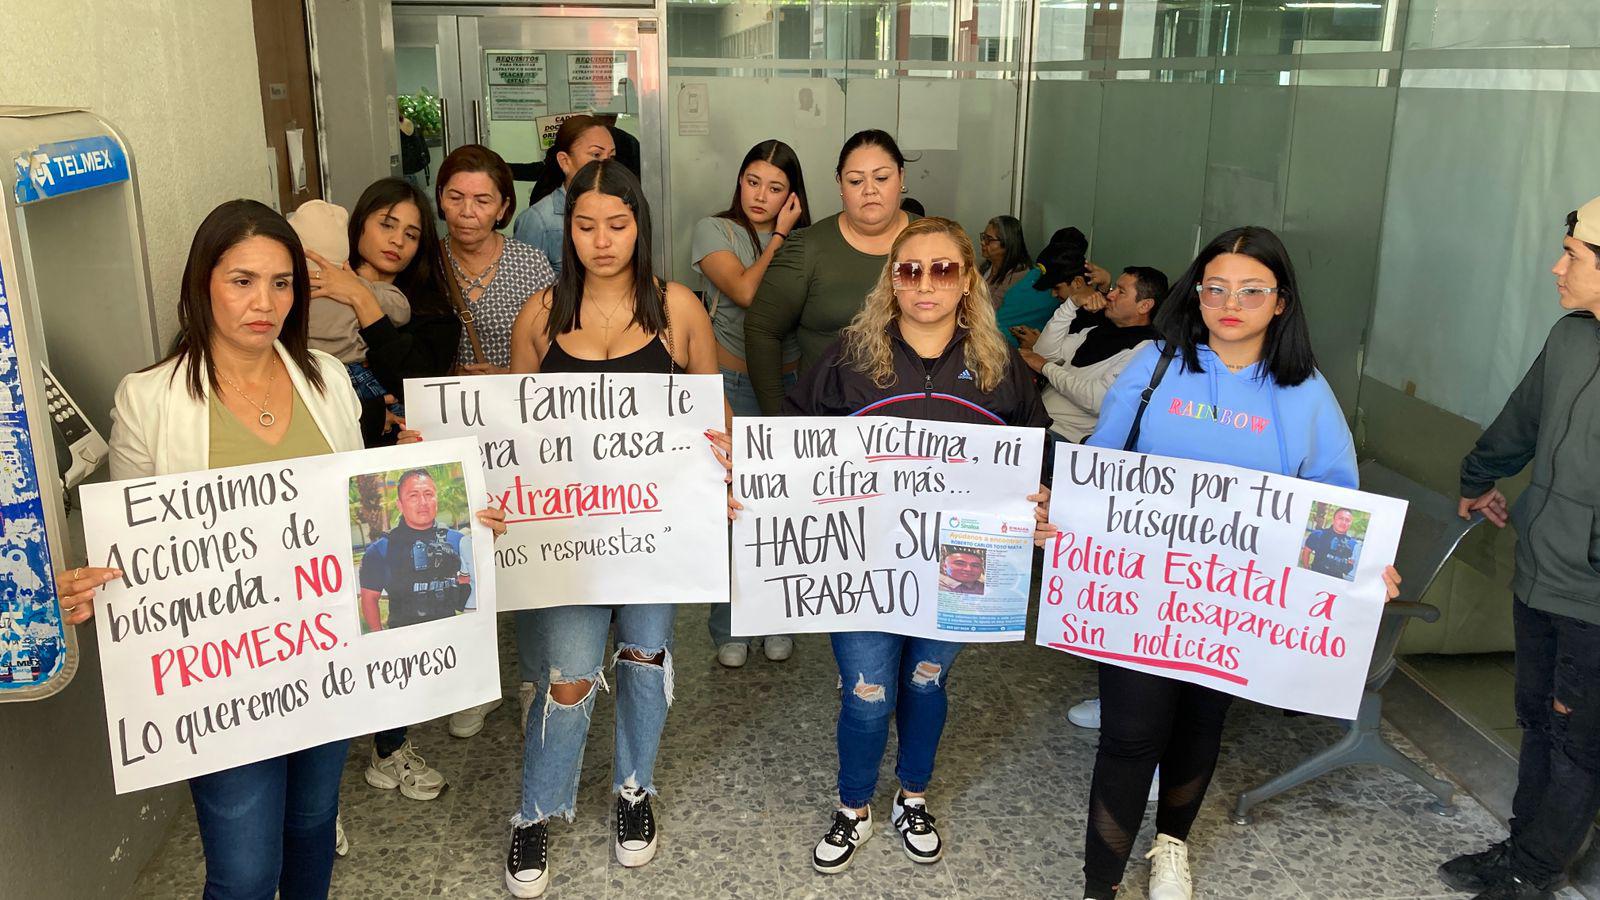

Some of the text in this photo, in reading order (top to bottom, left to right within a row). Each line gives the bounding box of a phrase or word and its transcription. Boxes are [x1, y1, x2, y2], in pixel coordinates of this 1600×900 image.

[555, 115, 574, 123] CAD
[53, 149, 113, 178] TELMEX
[424, 374, 694, 427] Tu familia te
[1168, 398, 1271, 434] RAINBOW
[539, 431, 574, 464] en
[746, 423, 773, 460] Ni
[794, 427, 839, 459] una
[993, 437, 1022, 467] ni
[123, 467, 299, 529] Exigimos
[740, 472, 789, 500] una
[812, 460, 879, 497] cifra
[1069, 450, 1295, 524] Unidos por tu
[101, 513, 320, 591] Acciones de
[745, 506, 942, 567] HAGAN SU
[1106, 495, 1260, 555] búsqueda
[107, 554, 343, 643] búsqueda. NO
[764, 568, 920, 618] TRABAJO
[1164, 551, 1291, 609] Estatal
[1309, 591, 1338, 621] a
[1047, 575, 1063, 606] 8
[1077, 581, 1139, 616] días
[1157, 591, 1347, 659] desaparecido
[1062, 613, 1240, 672] Sin noticias
[151, 612, 349, 696] PROMESAS.
[118, 643, 458, 767] Lo queremos de regreso
